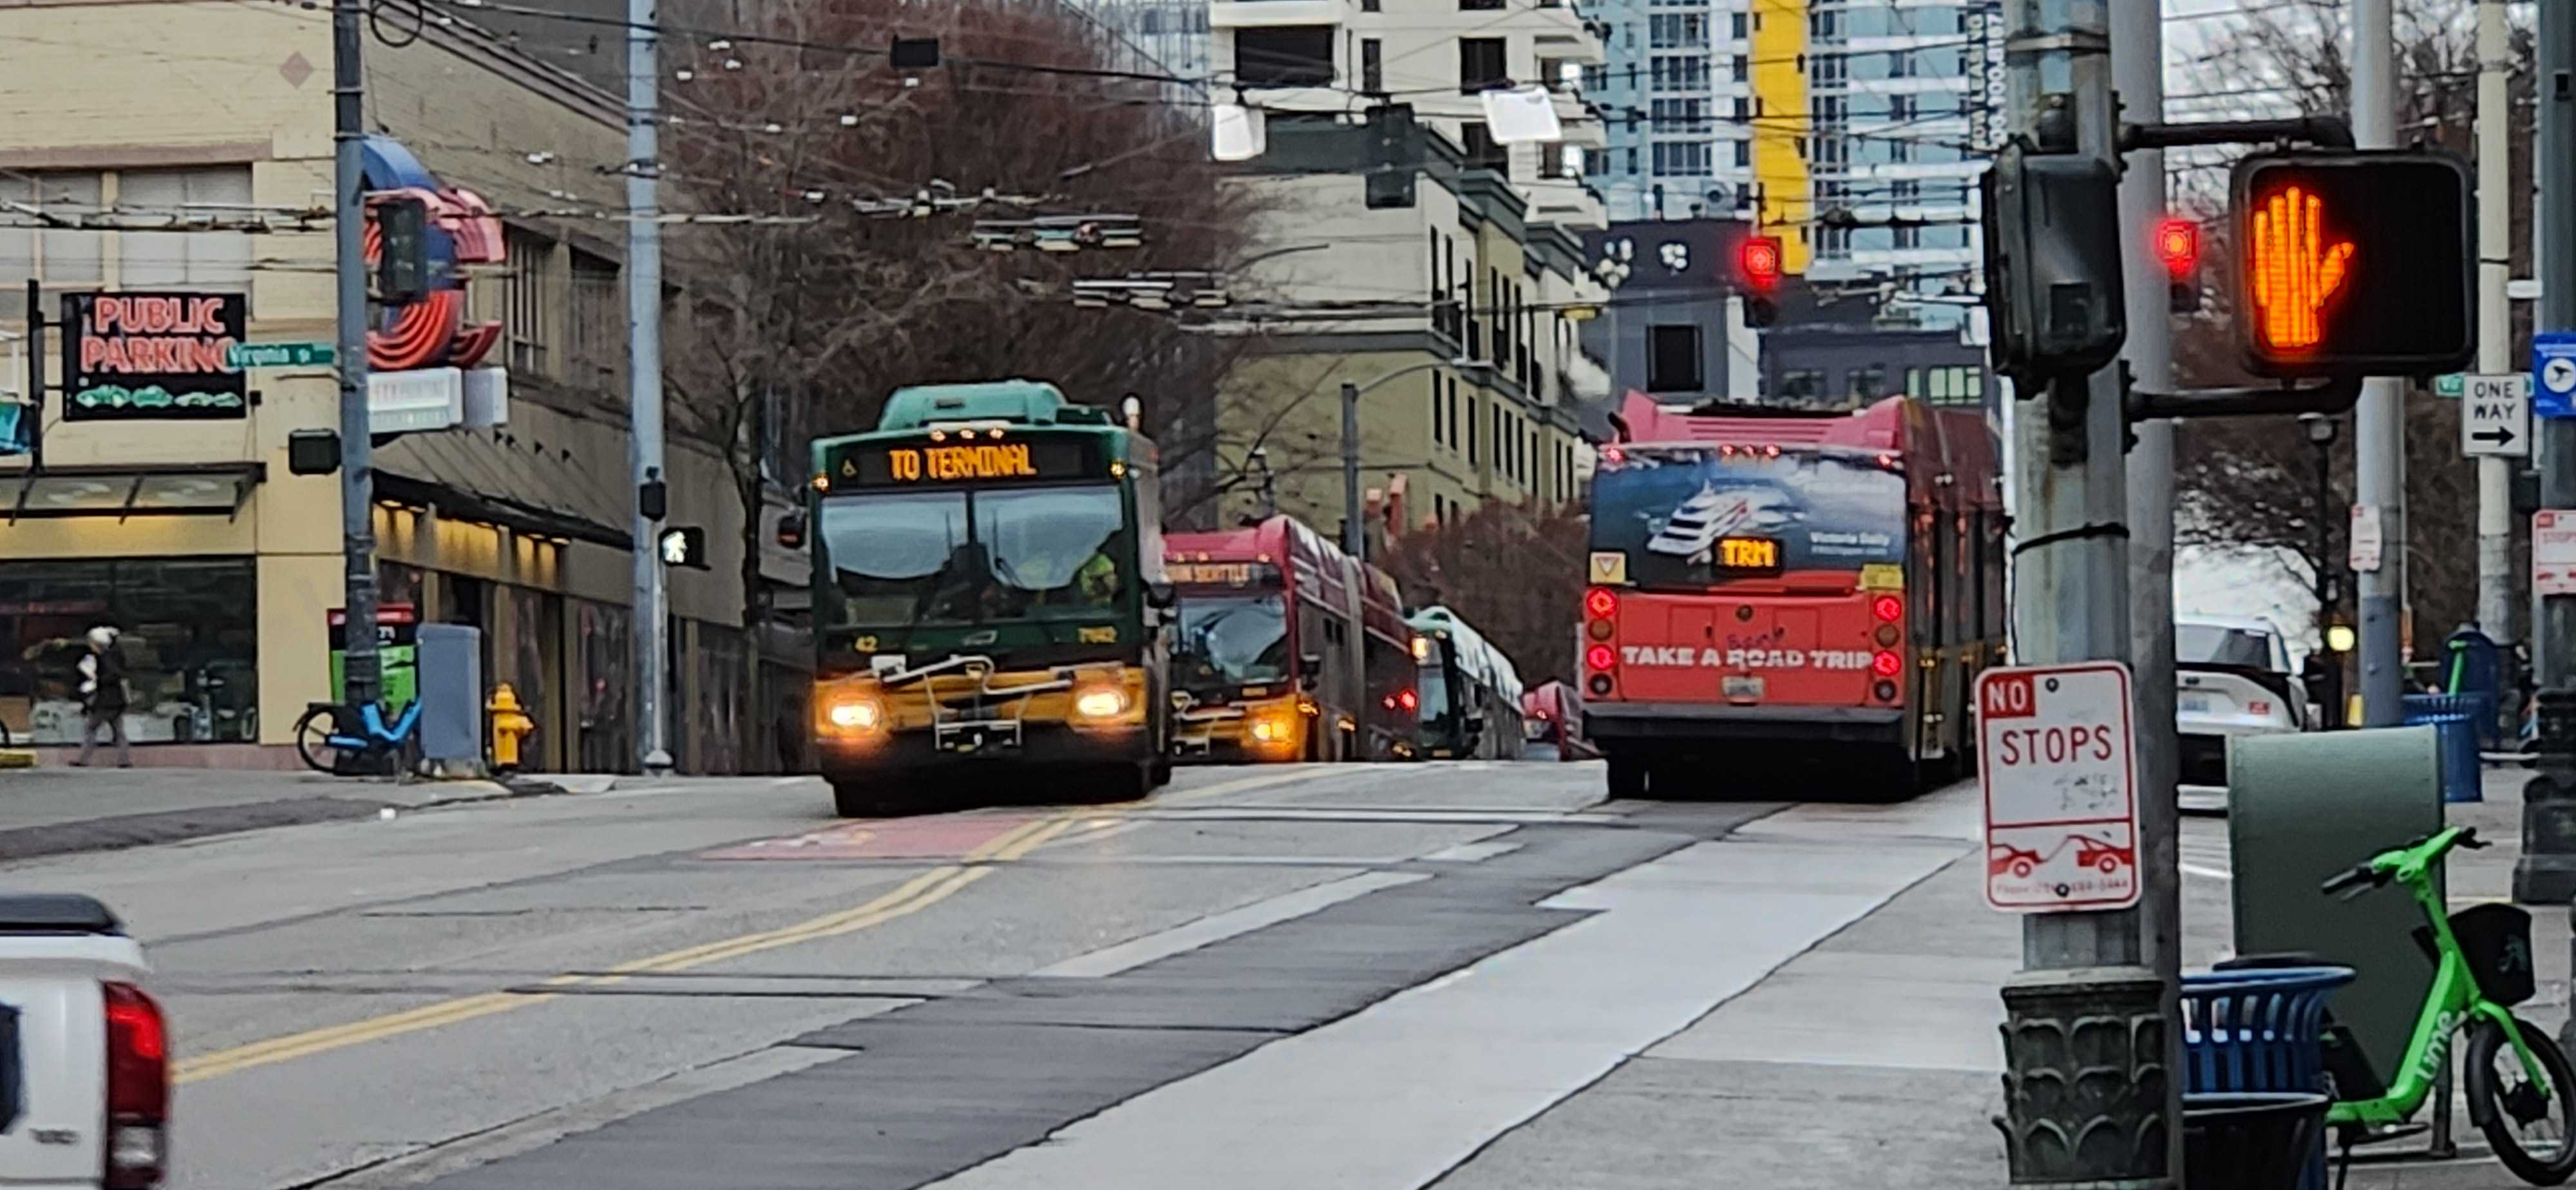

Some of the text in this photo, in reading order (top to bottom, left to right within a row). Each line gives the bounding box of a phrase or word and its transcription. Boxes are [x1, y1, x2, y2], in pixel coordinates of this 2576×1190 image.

[95, 298, 225, 333] PUBLIC
[2474, 382, 2514, 399] ONE
[2474, 403, 2516, 420] WAY
[889, 443, 1037, 480] TO TERMINAL
[1720, 539, 1776, 567] TRM
[855, 636, 878, 652] 42
[1620, 646, 1873, 670] TAKE A ROAD TRIP
[1987, 680, 2027, 712] NO
[2000, 724, 2112, 766] STOPS
